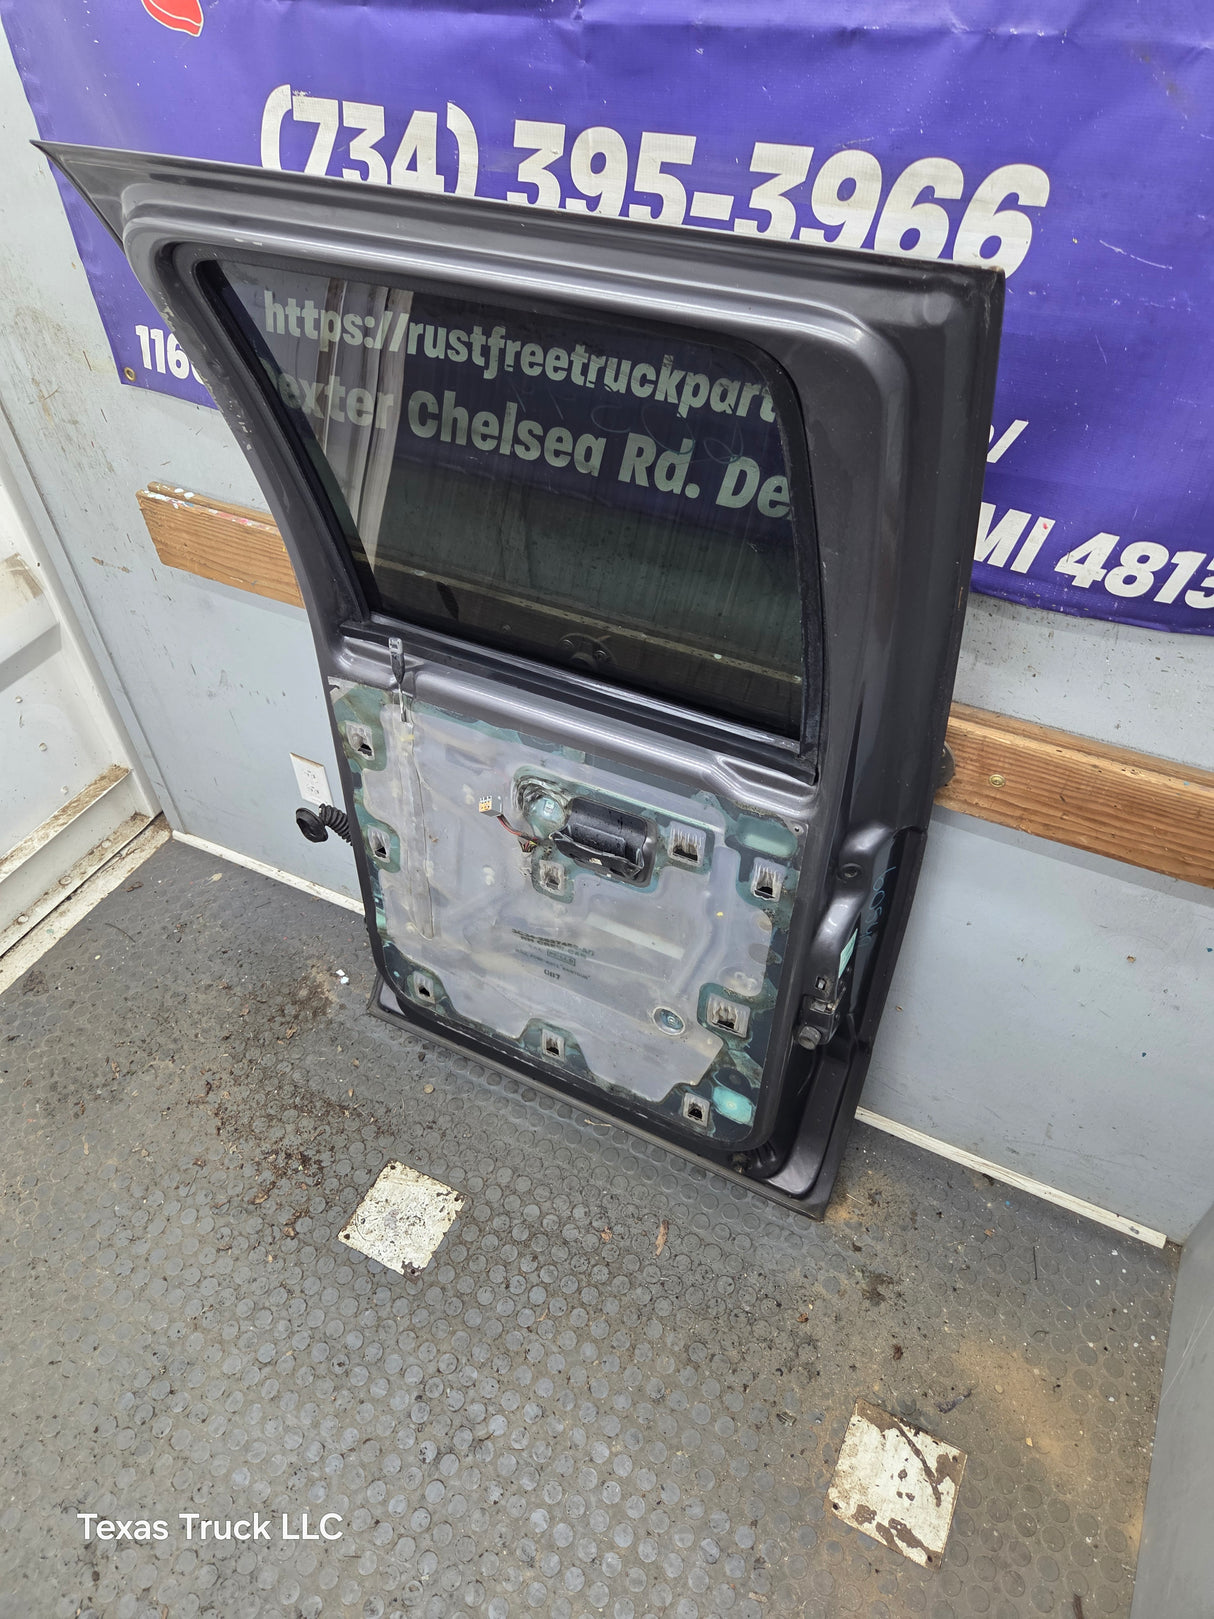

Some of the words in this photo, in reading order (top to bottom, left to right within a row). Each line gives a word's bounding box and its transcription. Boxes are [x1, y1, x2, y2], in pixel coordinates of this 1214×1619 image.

[260, 84, 479, 198] (734)
[507, 119, 1050, 279] 395-3966
[407, 390, 607, 477] Chelsea
[618, 433, 700, 500] Rd.
[715, 456, 798, 520] De
[973, 501, 1056, 574] MI
